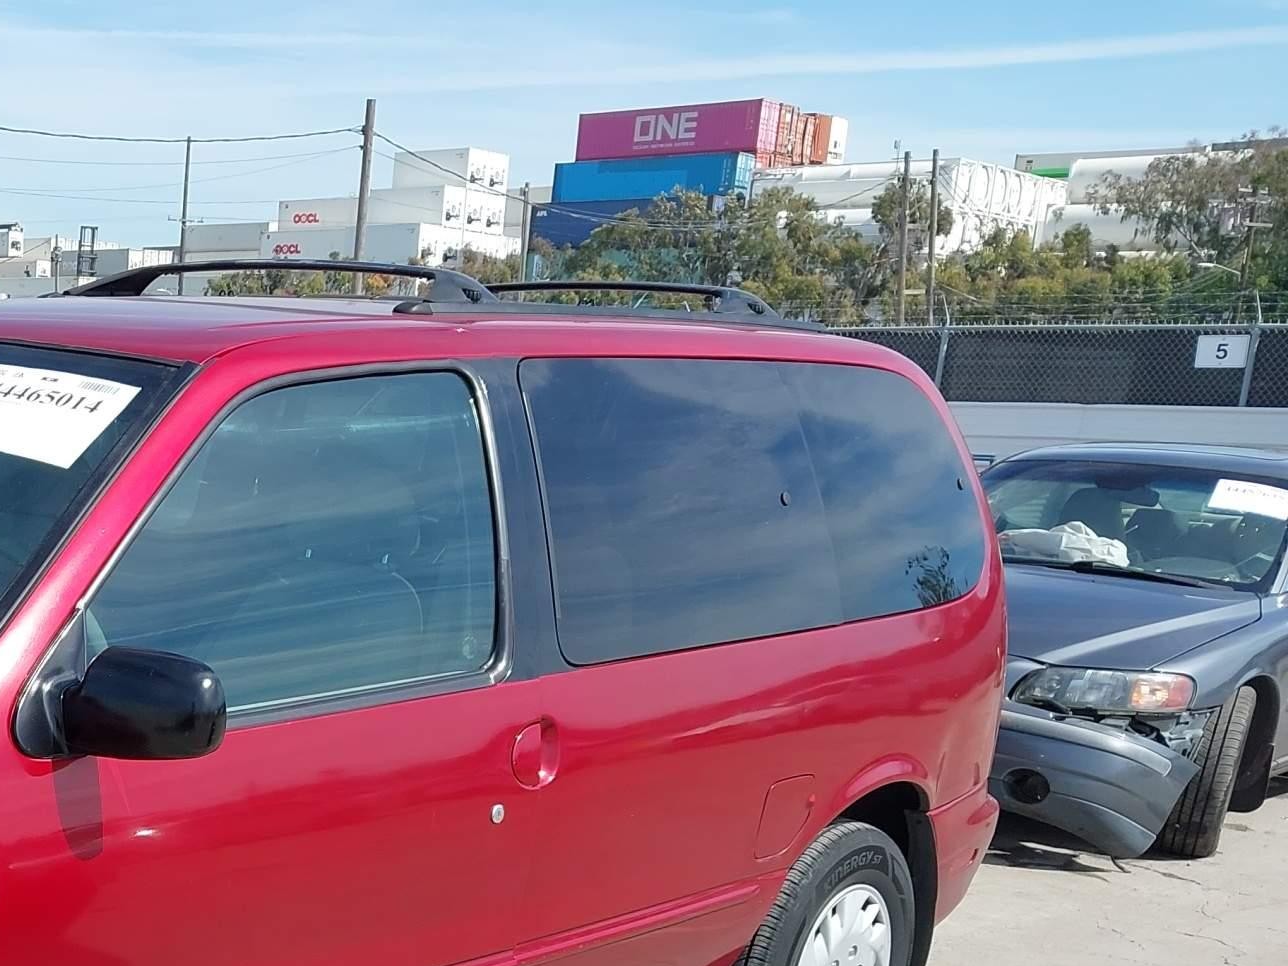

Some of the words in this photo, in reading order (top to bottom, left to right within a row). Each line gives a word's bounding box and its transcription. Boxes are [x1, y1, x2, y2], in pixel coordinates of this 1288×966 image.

[633, 112, 698, 142] ONE
[293, 213, 319, 224] OOCL
[274, 244, 301, 255] OOCL
[1215, 343, 1229, 360] 5
